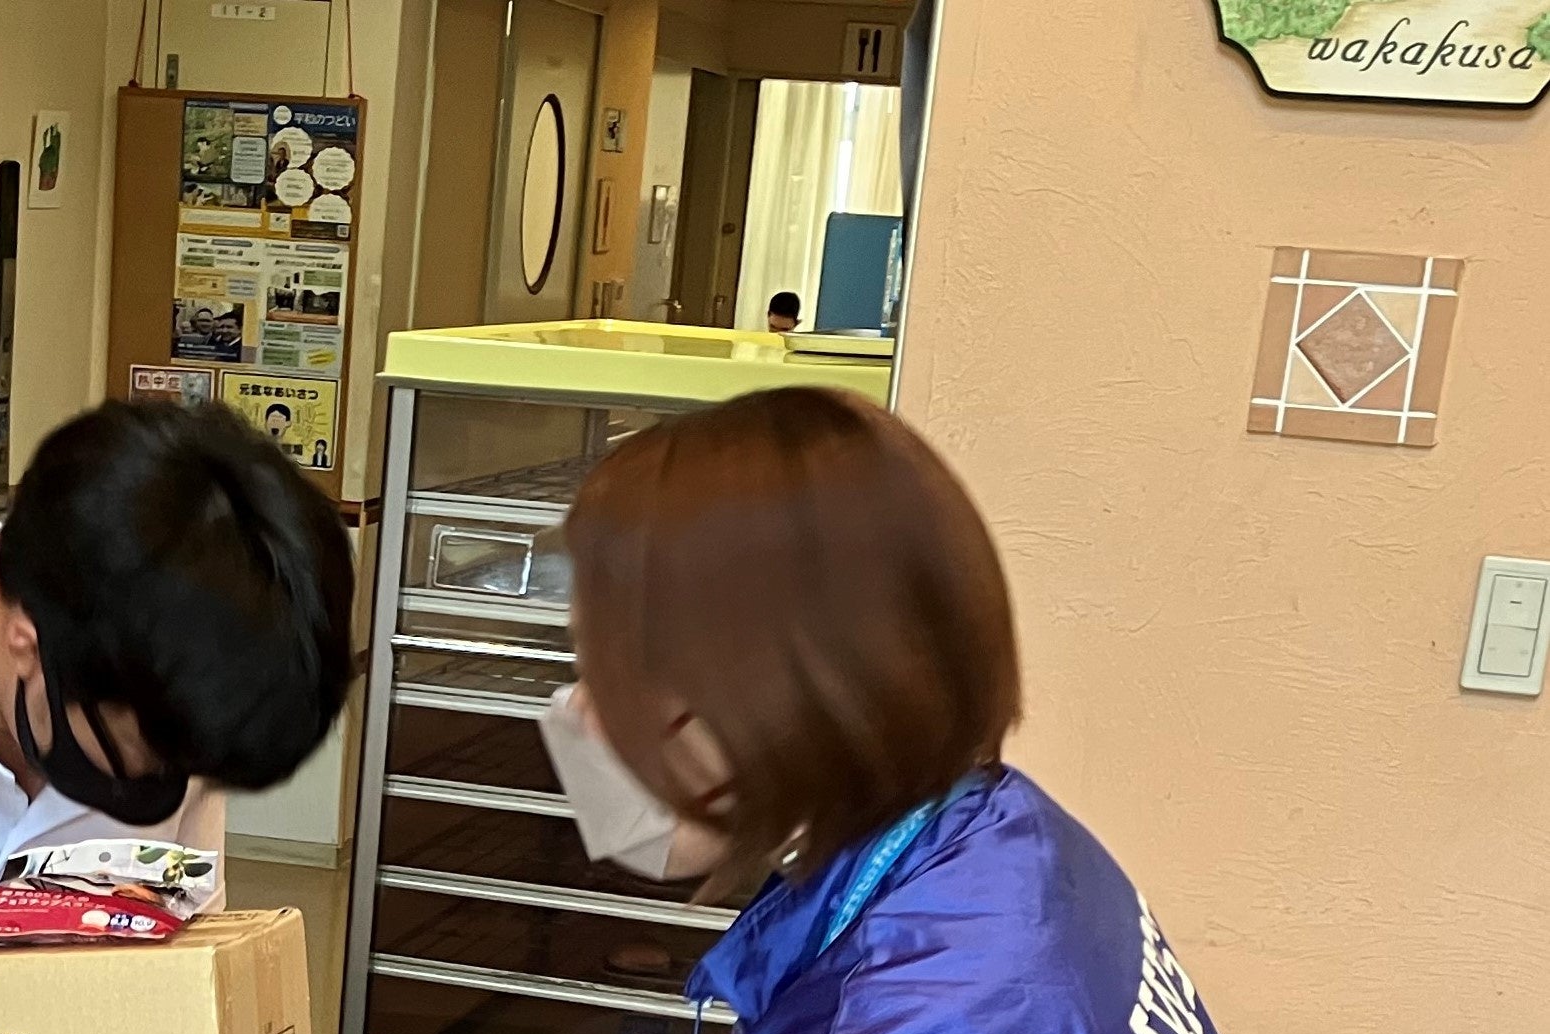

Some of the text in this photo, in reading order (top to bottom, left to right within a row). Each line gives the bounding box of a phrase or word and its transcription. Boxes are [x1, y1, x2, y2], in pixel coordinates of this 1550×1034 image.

[1307, 17, 1537, 76] wakakusa
[239, 383, 319, 400] 元気なあいさつ
